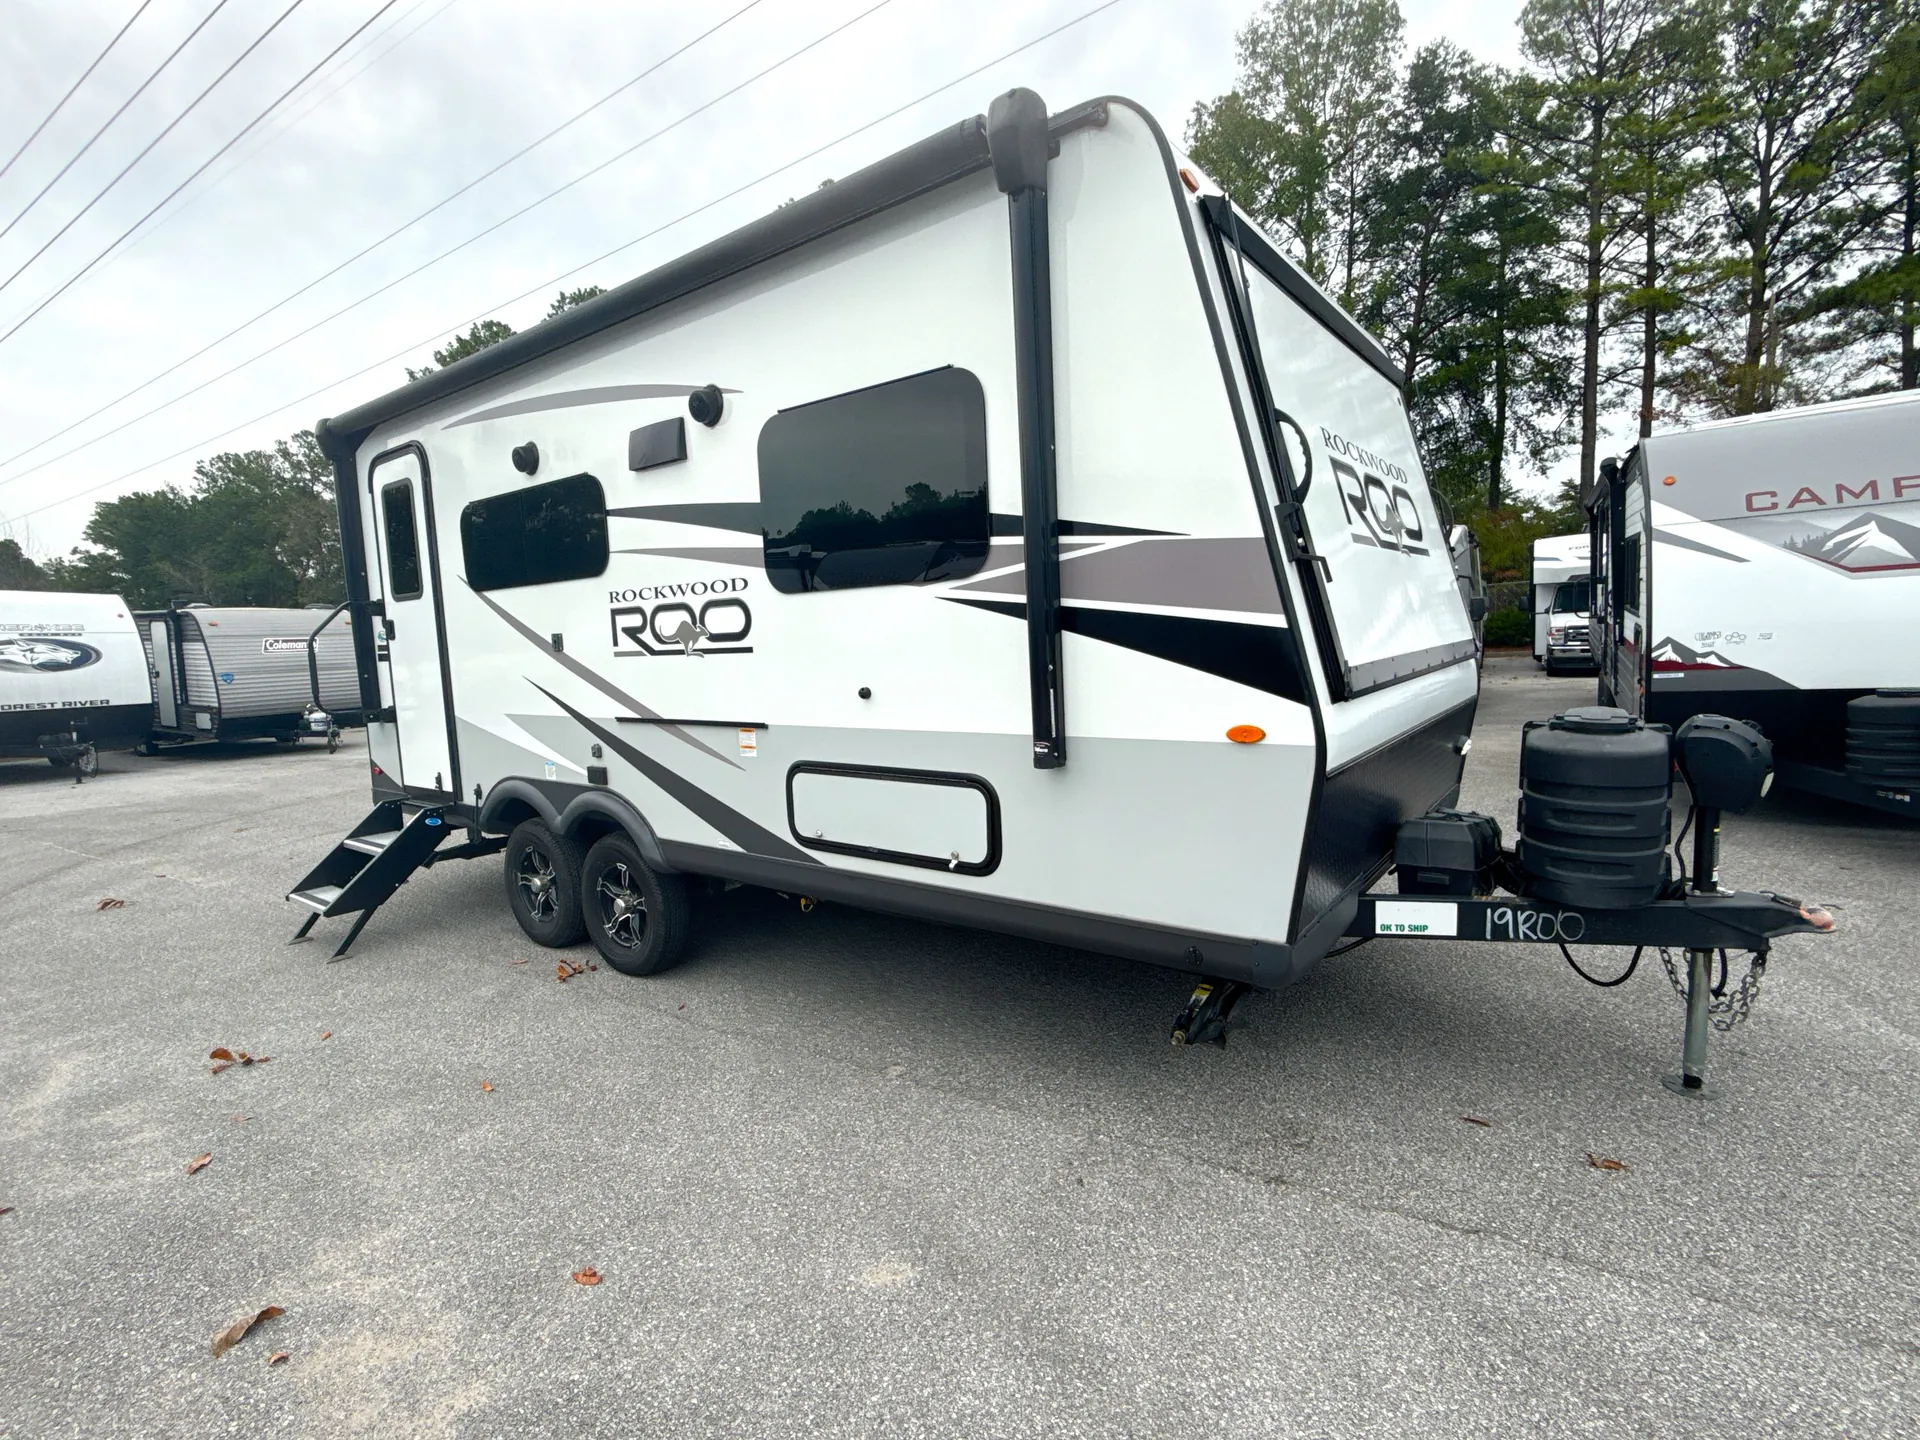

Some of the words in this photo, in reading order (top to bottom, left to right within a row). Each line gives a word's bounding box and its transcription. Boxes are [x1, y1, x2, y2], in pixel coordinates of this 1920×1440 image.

[1320, 426, 1408, 484] ROCKWOOD
[1328, 455, 1424, 550] ROO
[608, 577, 749, 604] ROCKWOOD
[610, 597, 753, 656] ROO
[266, 640, 307, 650] Coleman
[62, 699, 110, 708] RIVER
[1380, 923, 1392, 932] OK
[1394, 924, 1405, 932] TO
[1407, 924, 1429, 933] SHIP
[1485, 907, 1585, 941] 19ROO
